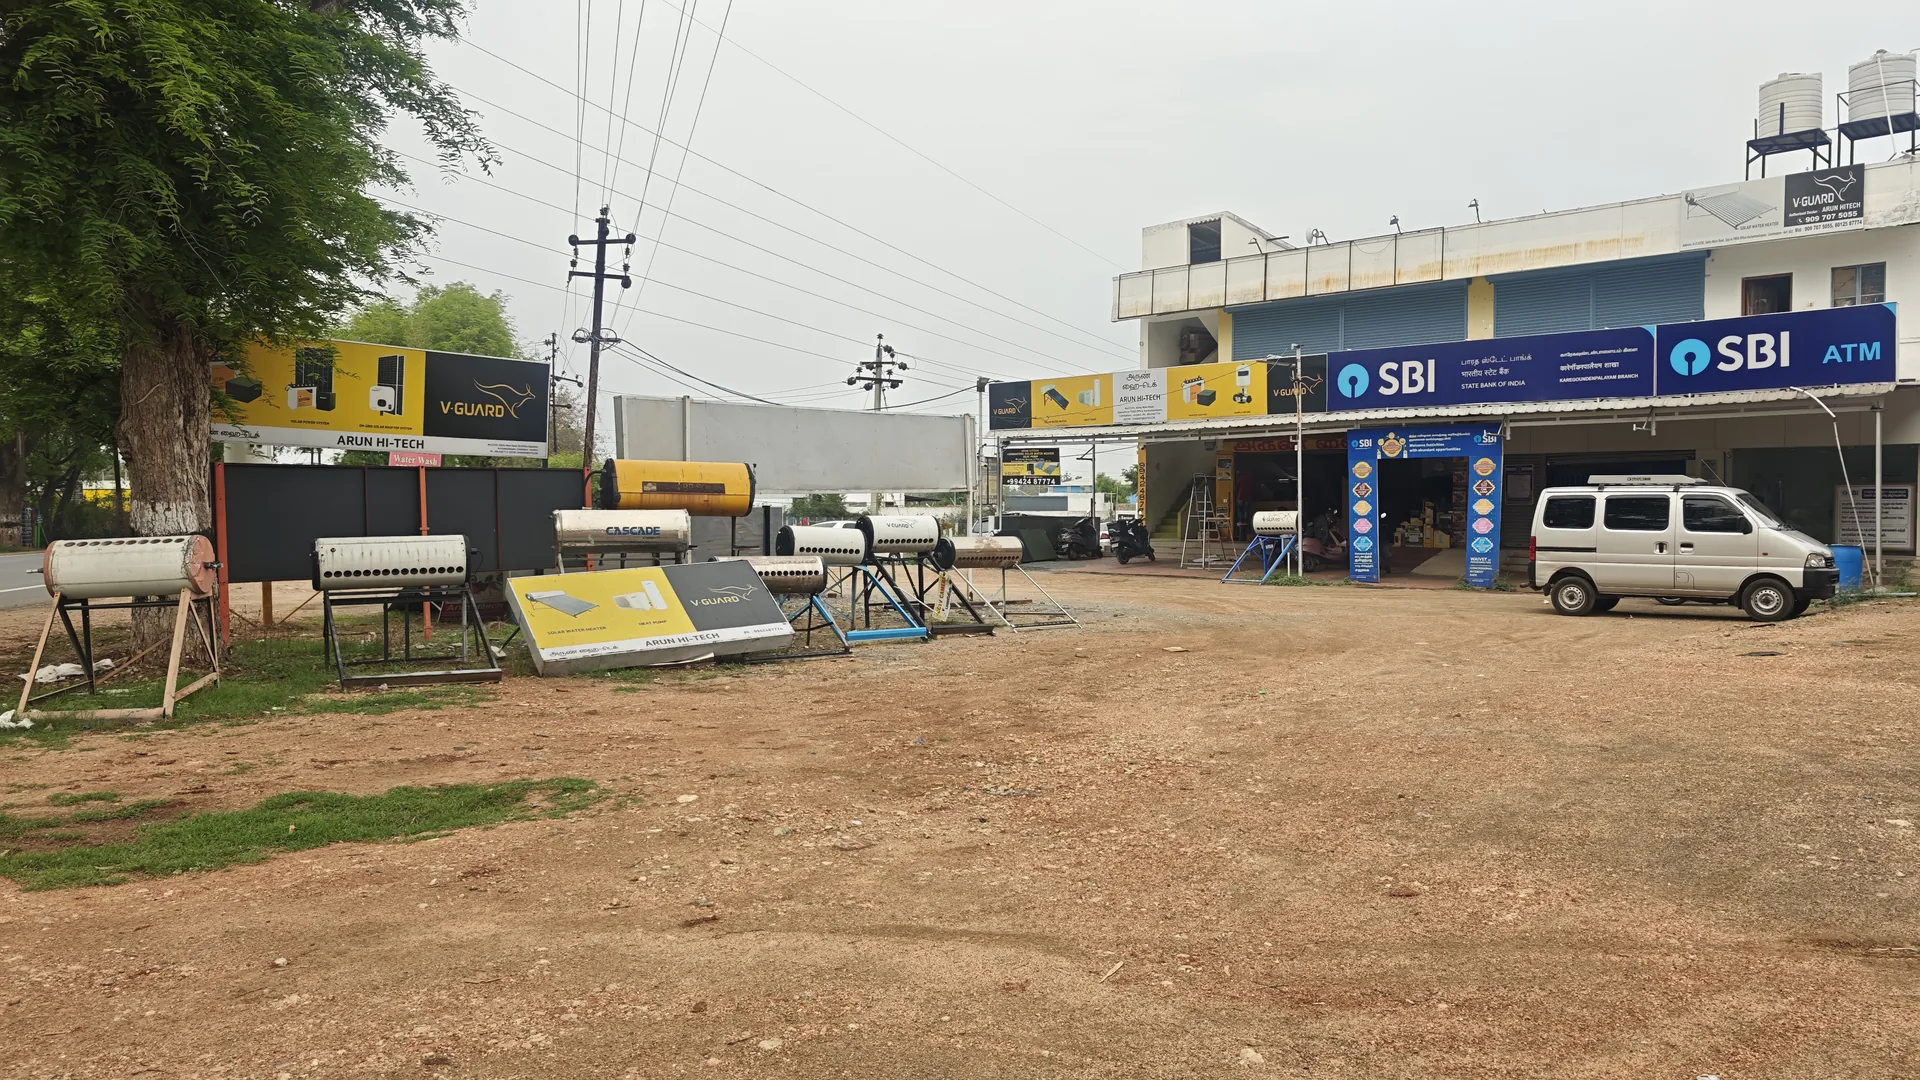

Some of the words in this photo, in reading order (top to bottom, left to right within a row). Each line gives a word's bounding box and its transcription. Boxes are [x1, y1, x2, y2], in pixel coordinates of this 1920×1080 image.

[1792, 192, 1834, 208] V-GUARD
[1822, 205, 1838, 213] ARUN
[1840, 202, 1861, 210] HITECH
[1806, 215, 1820, 223] 909
[1838, 210, 1858, 218] 5055
[1717, 331, 1790, 372] SBI
[1822, 342, 1880, 364] ATM
[1482, 355, 1508, 364] ஸ்டேட்
[1510, 353, 1532, 362] பாங்க்
[1378, 359, 1435, 395] SBI
[1461, 369, 1482, 378] भारतीय
[1484, 368, 1497, 376] स्टेट
[440, 401, 504, 418] V-GUARD
[337, 435, 372, 446] ARUN
[377, 438, 424, 449] HI-TECH
[1359, 439, 1372, 448] SBI
[394, 454, 415, 464] Water
[418, 455, 437, 465] Wash
[606, 526, 660, 536] CASCADE
[690, 596, 740, 606] V-GUARD
[678, 633, 719, 643] HI-TECH
